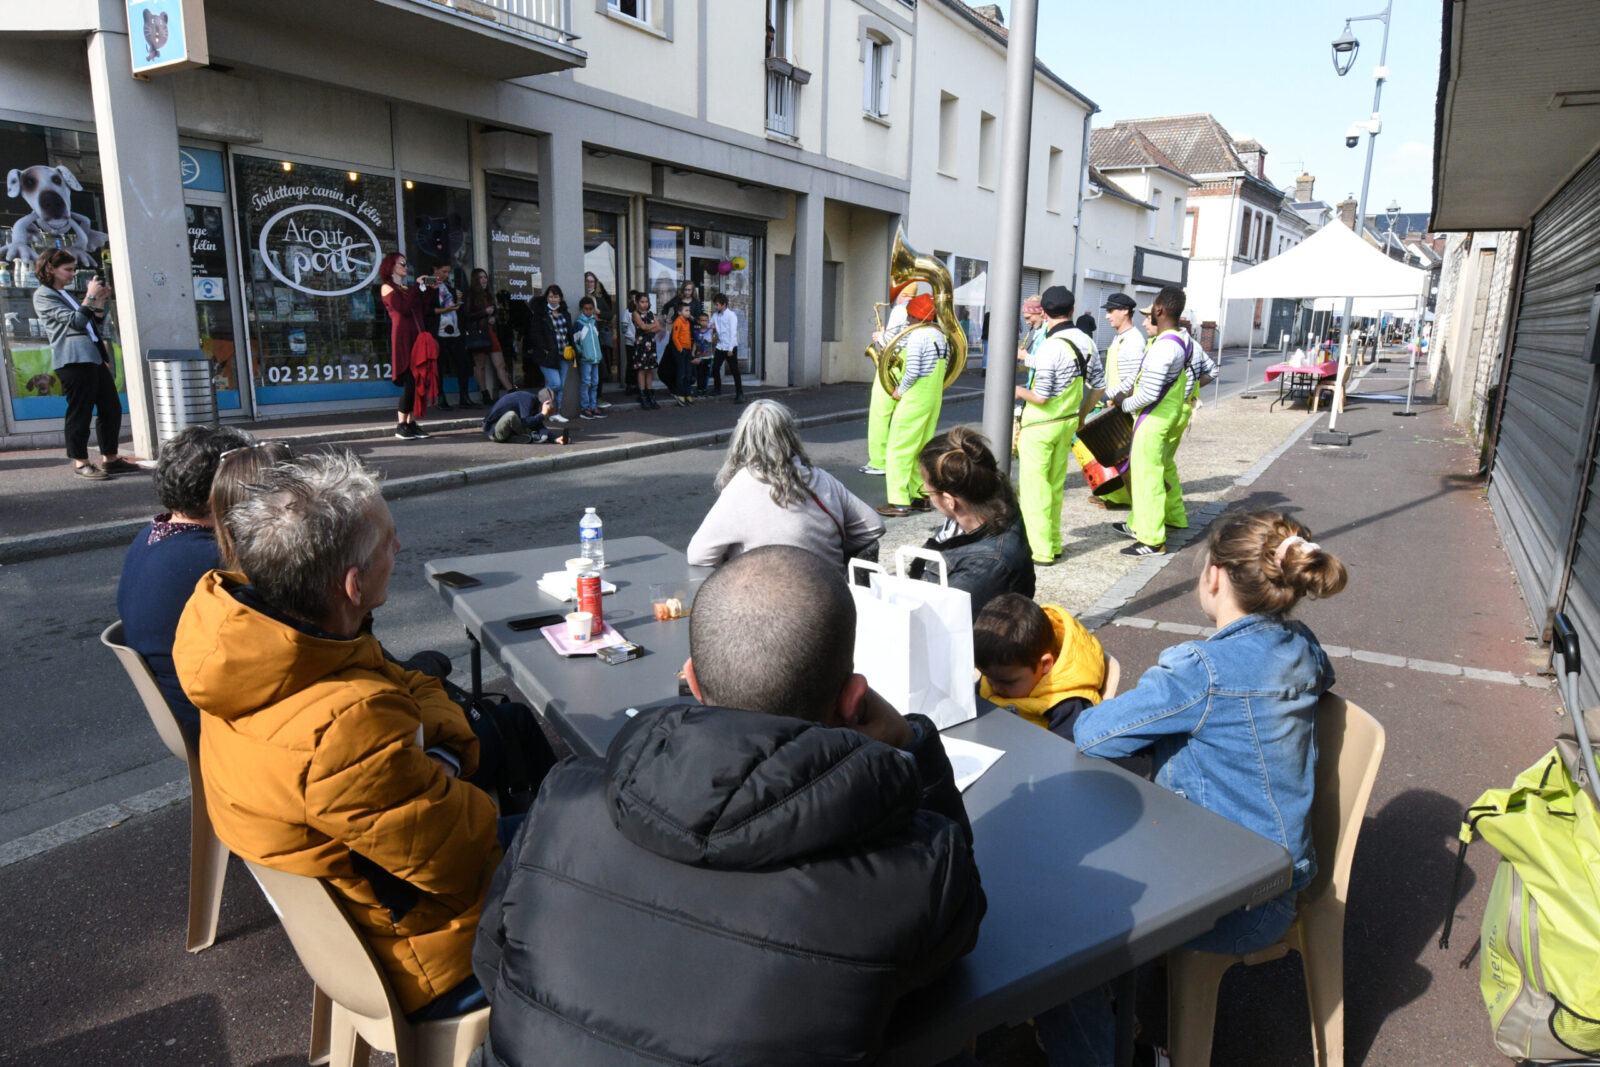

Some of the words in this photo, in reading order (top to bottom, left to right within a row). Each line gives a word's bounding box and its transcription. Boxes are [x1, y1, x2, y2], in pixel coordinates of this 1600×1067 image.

[252, 185, 310, 211] Toilettage
[312, 187, 344, 202] canin
[346, 194, 358, 207] &
[357, 201, 382, 227] félin
[188, 227, 208, 239] age
[282, 218, 344, 249] Atout
[491, 230, 510, 242] Salon
[193, 238, 217, 253] félin
[508, 247, 530, 257] homme
[293, 236, 357, 285] poil
[508, 262, 541, 274] shampoing
[509, 278, 527, 288] coupe
[268, 366, 292, 382] 02
[297, 365, 319, 382] 32
[323, 365, 342, 380] 91
[349, 364, 369, 379] 32
[373, 363, 393, 378] 12
